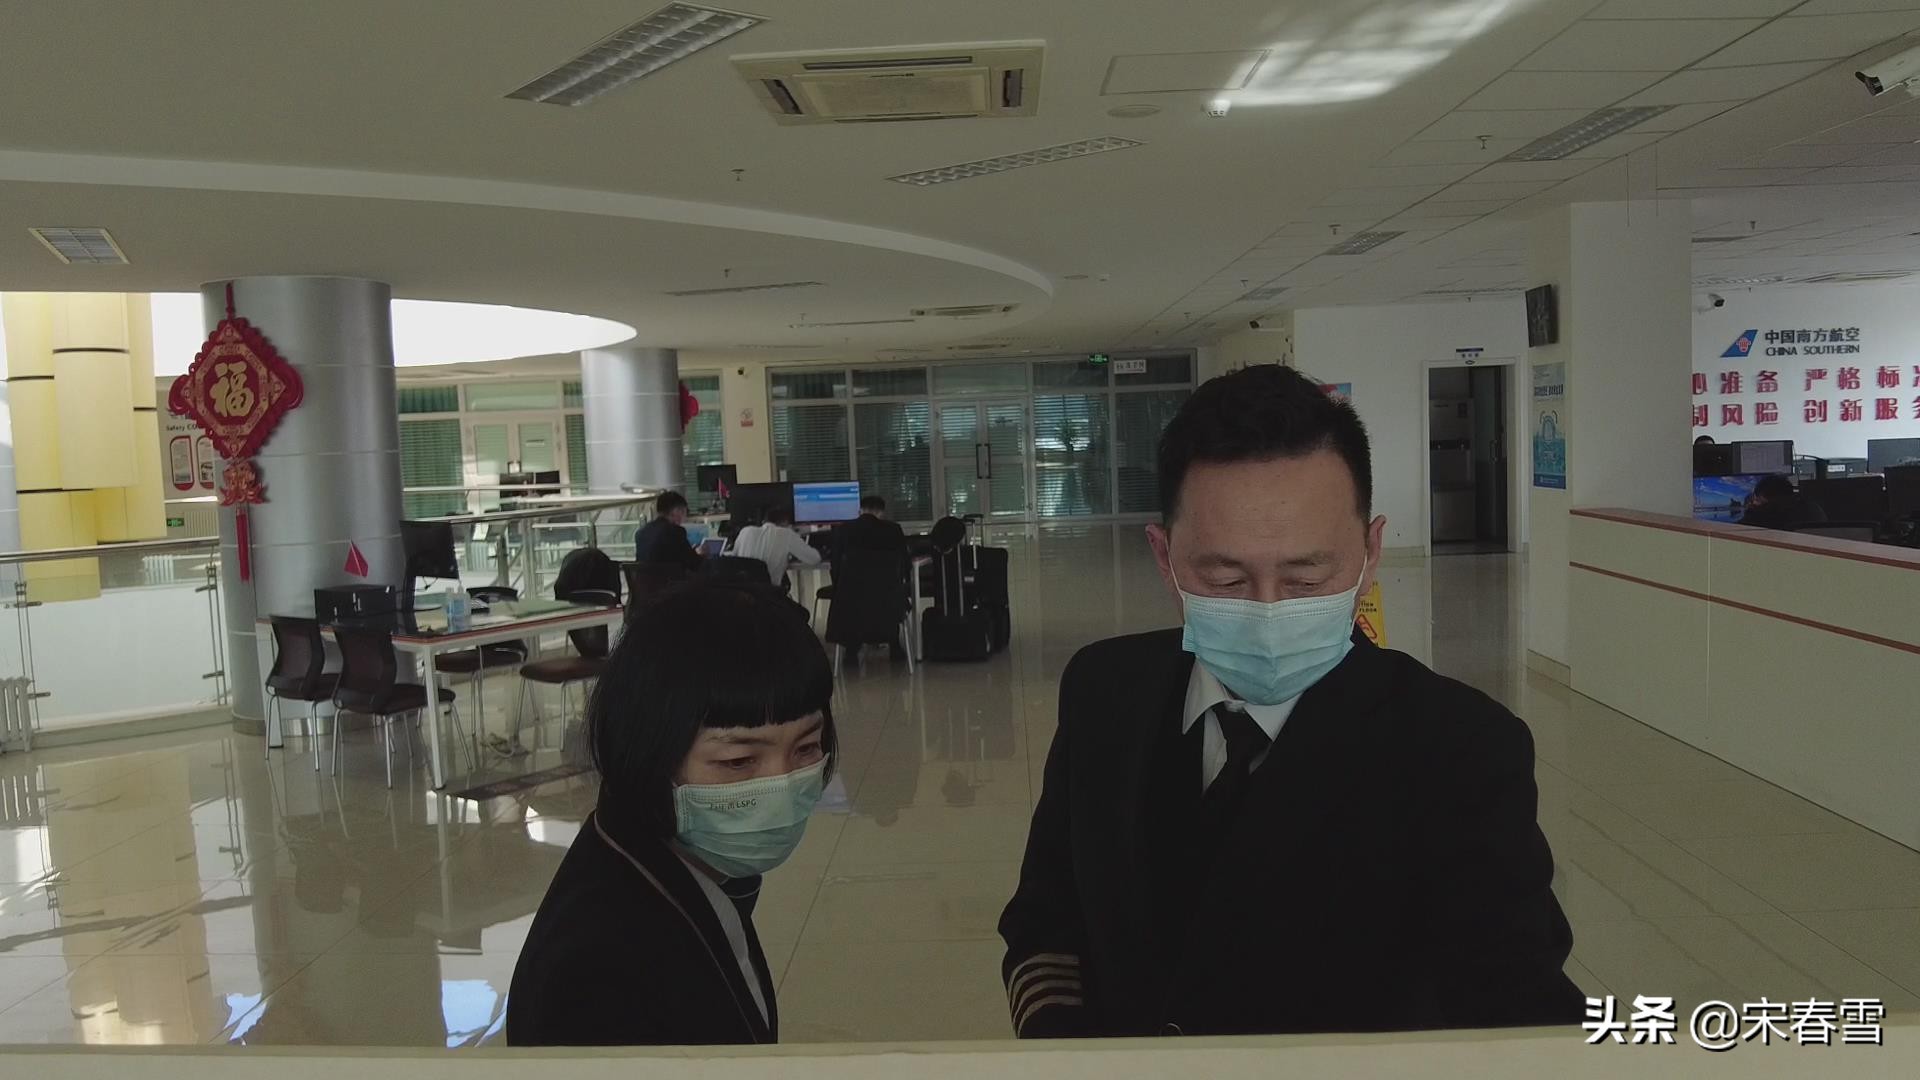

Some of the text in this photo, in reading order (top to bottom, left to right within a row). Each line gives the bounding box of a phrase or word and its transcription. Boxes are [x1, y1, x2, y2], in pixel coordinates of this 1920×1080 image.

[1764, 327, 1860, 345] 中国南方航空
[1765, 345, 1860, 356] CHINA SOUTHERN
[209, 360, 255, 418] 福
